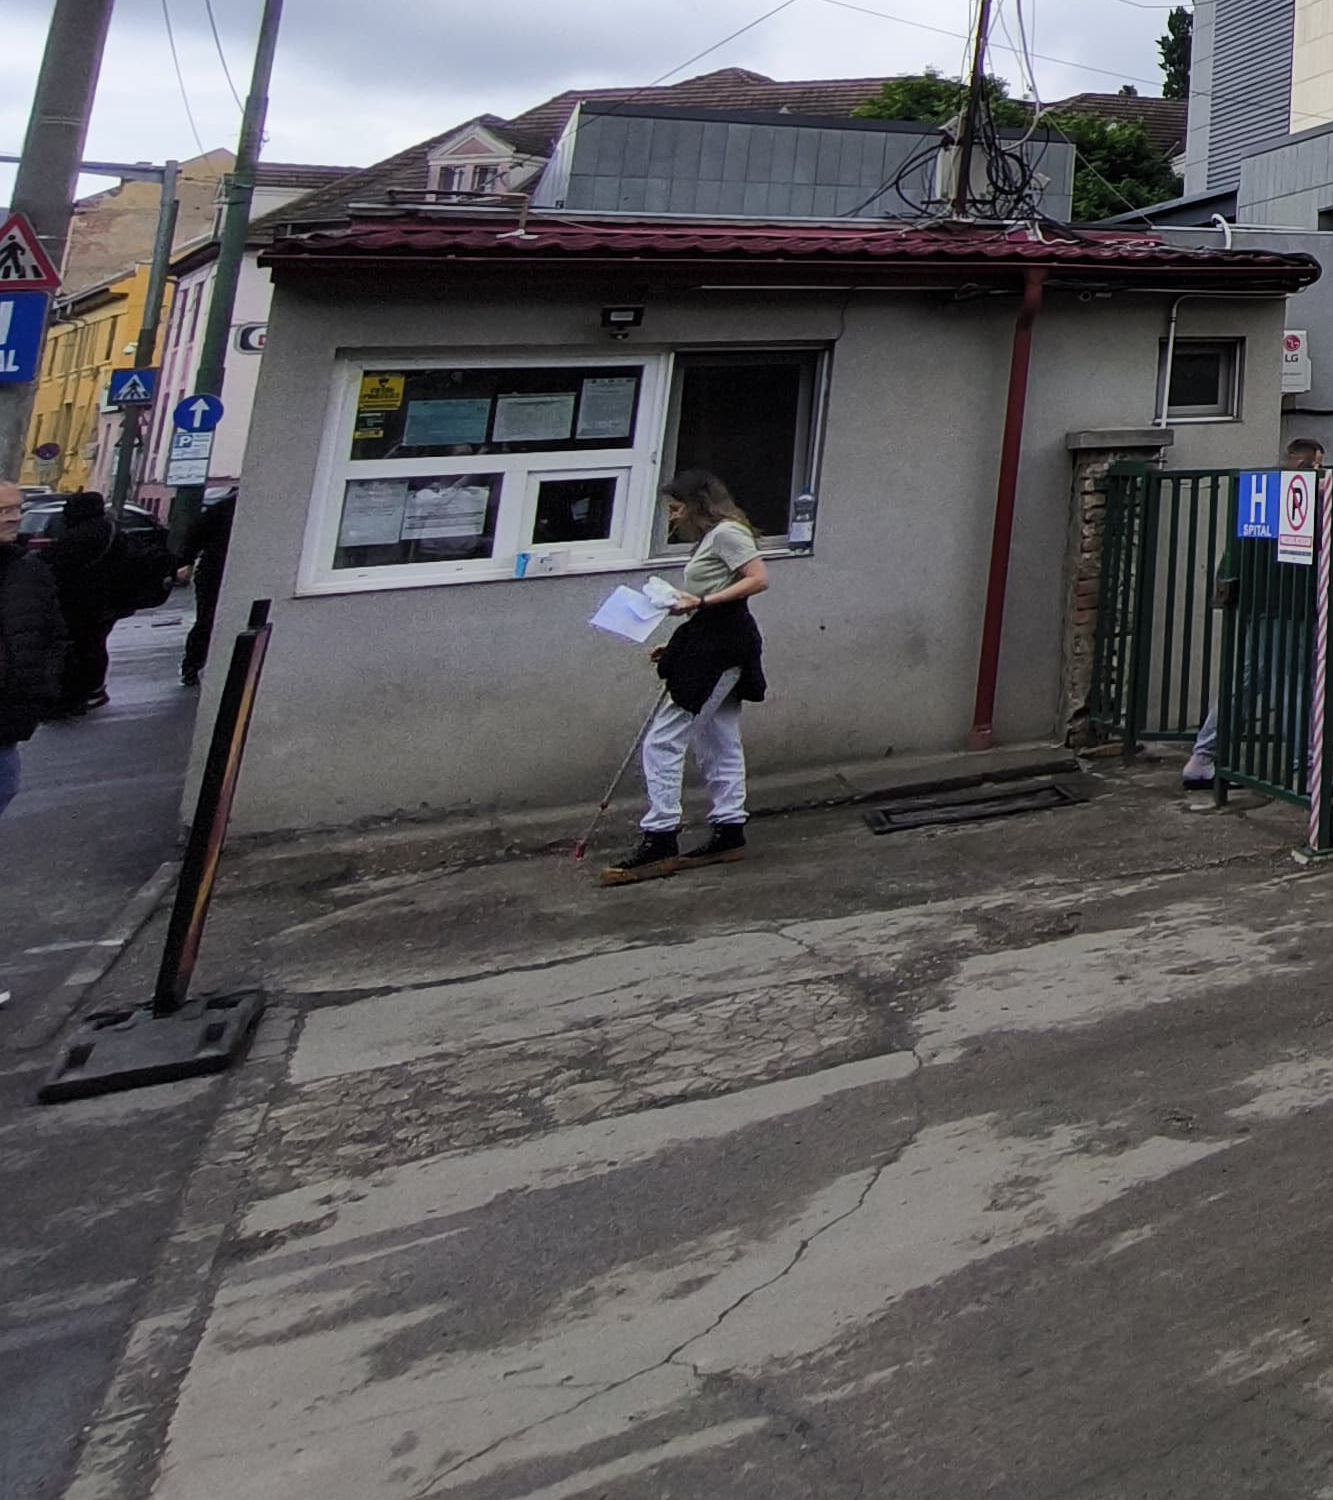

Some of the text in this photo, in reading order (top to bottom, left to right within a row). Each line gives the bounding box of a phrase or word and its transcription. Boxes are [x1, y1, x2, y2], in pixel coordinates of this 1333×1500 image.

[1284, 354, 1299, 363] LG
[1250, 474, 1267, 523] H
[1243, 524, 1272, 537] SPITAL
